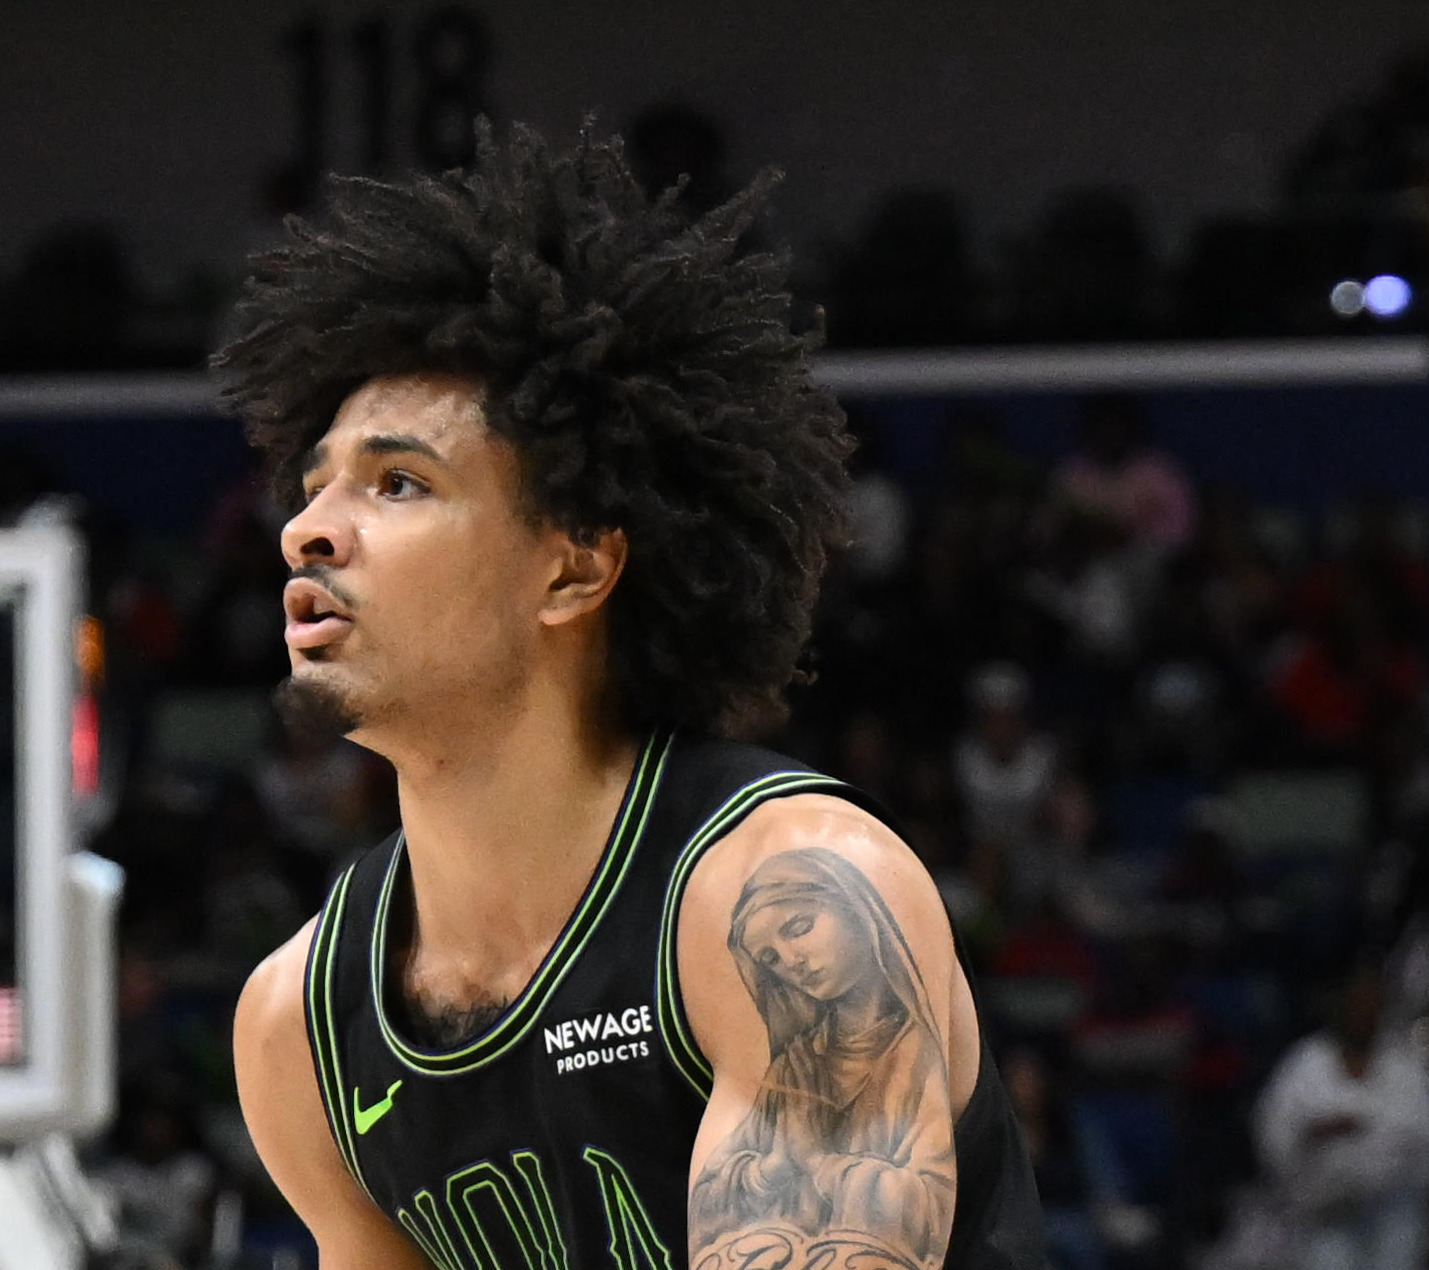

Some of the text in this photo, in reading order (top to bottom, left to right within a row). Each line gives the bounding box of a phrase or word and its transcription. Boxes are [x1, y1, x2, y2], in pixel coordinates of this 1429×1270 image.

[281, 10, 489, 173] 118
[544, 1005, 653, 1055] NEWAGE
[556, 1040, 650, 1075] PRODUCTS
